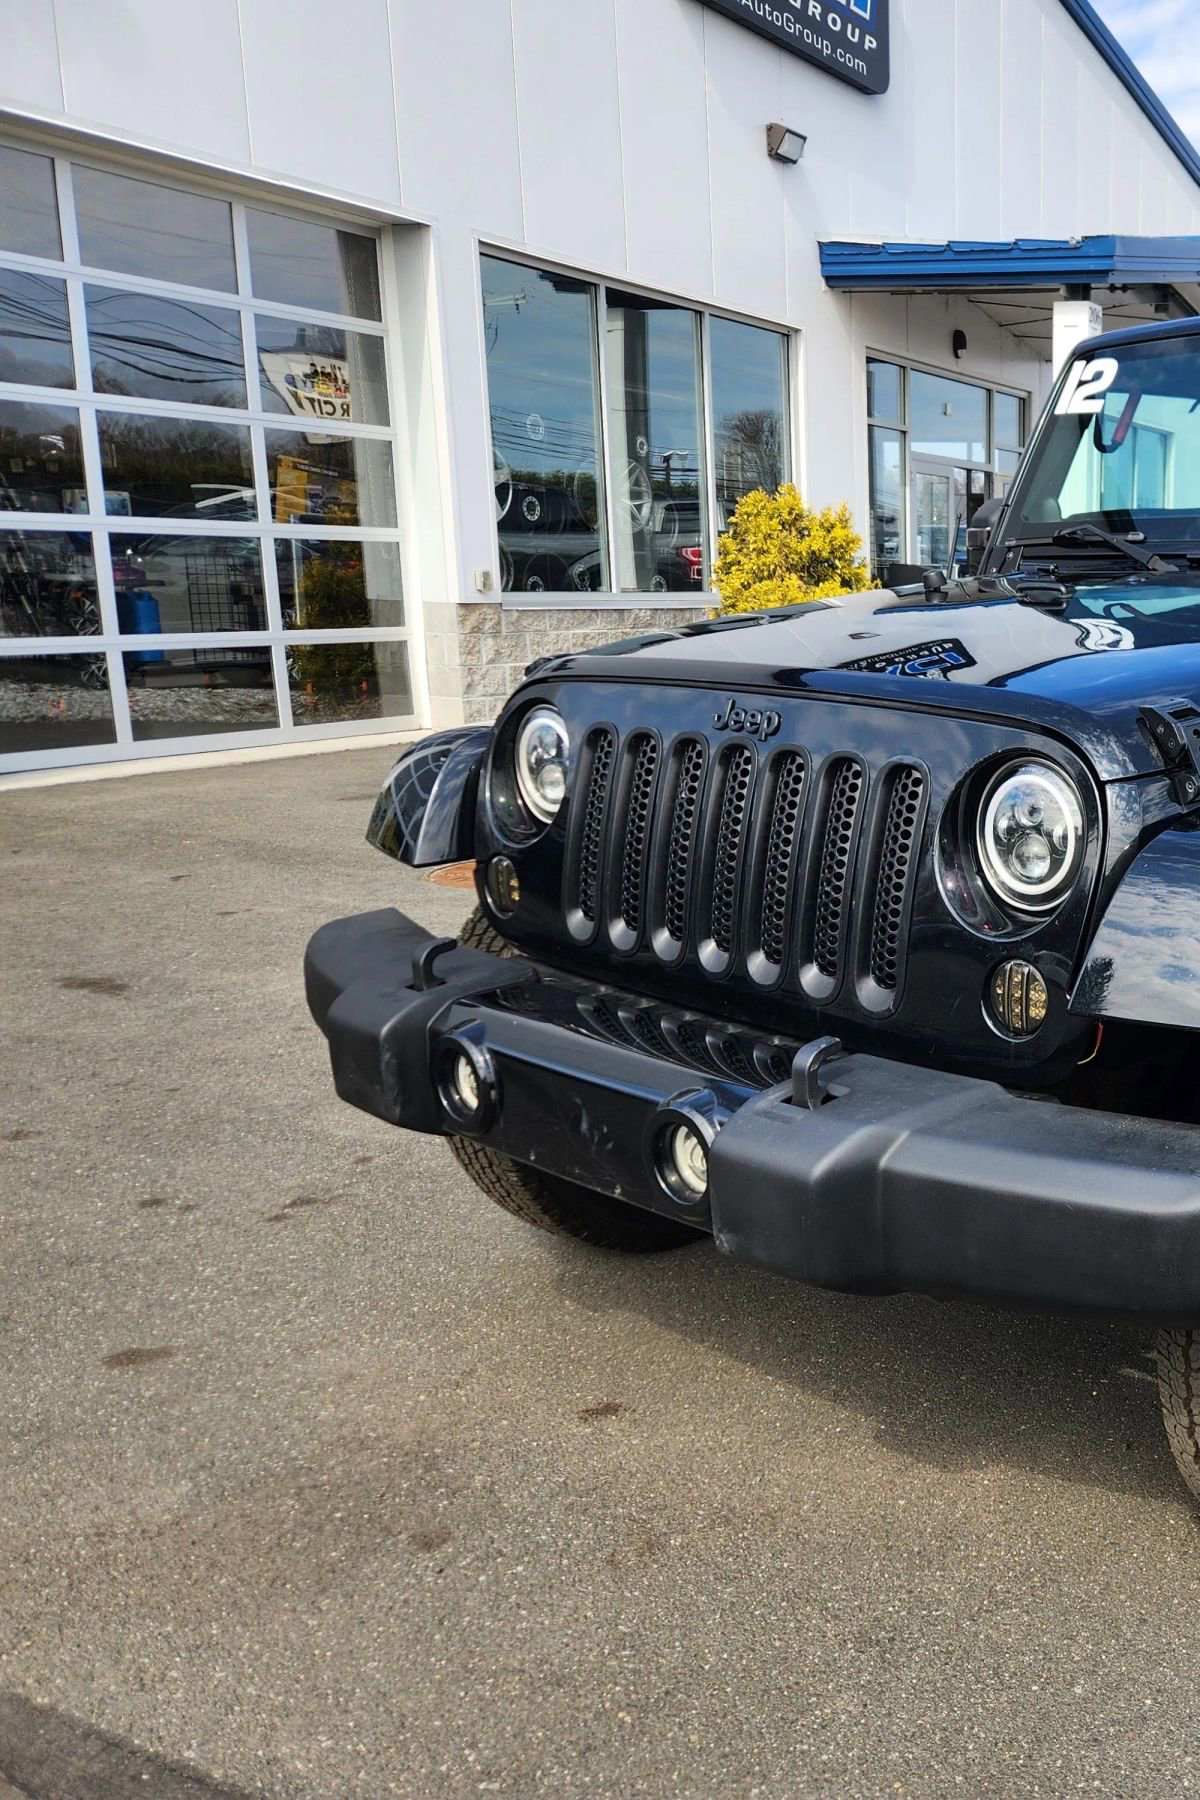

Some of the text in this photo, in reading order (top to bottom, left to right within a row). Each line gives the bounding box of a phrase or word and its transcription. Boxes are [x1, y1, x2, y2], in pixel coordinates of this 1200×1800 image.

[736, 0, 867, 75] AutoGroup.com
[1053, 357, 1119, 415] 12
[712, 698, 782, 742] Jeep
